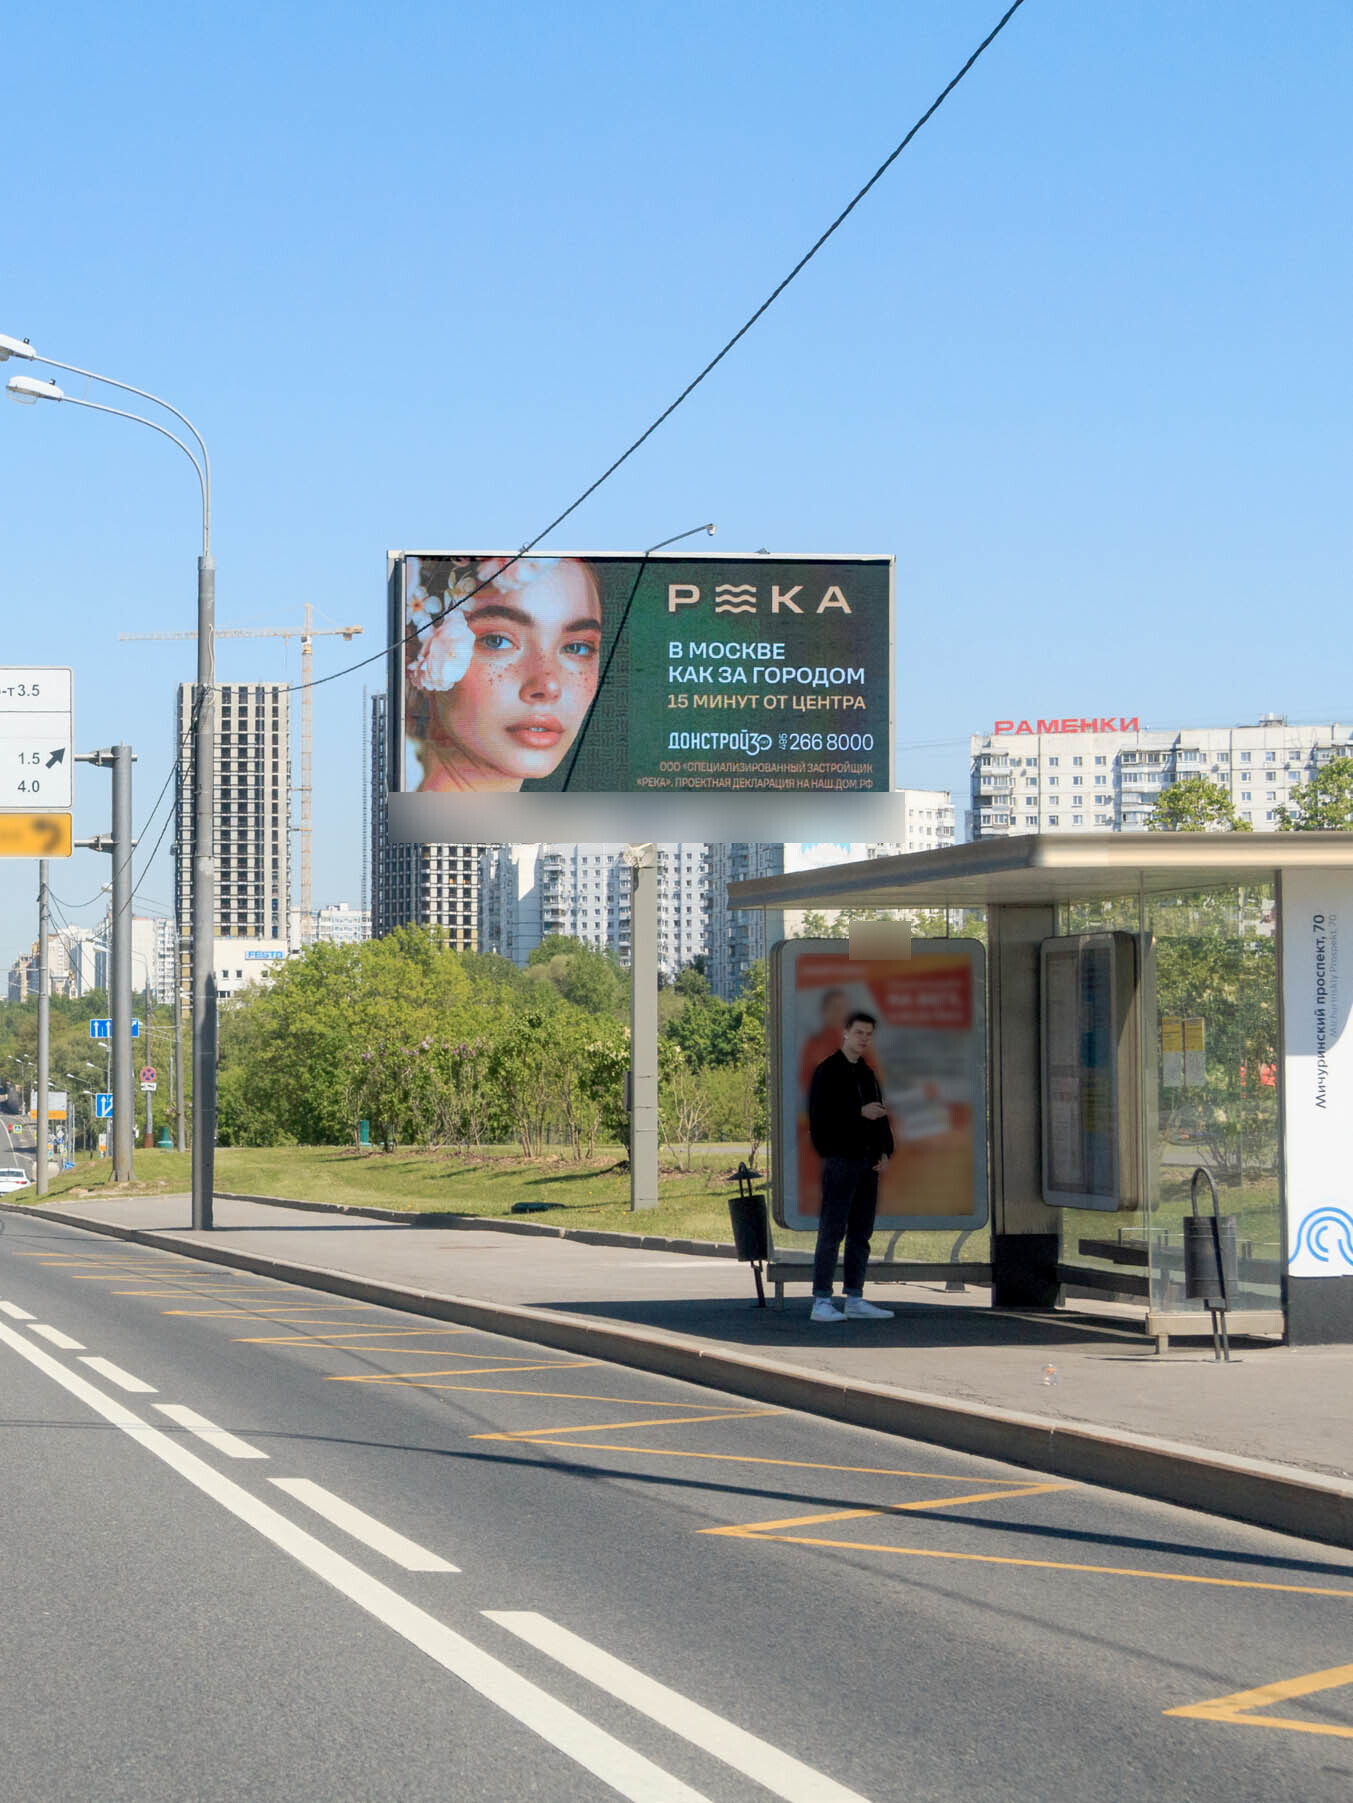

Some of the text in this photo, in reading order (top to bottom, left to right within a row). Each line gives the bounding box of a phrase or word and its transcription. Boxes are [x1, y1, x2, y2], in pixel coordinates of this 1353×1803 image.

[668, 642, 785, 660] В МОСКВЕ
[668, 666, 865, 688] КАК ЗА ГОРОДОМ
[17, 684, 40, 697] 3.5
[668, 694, 867, 712] 15 МИНУТ ОТ ЦЕНТРА
[994, 717, 1139, 735] РАМЕНКИ
[790, 733, 822, 751] 266
[826, 733, 874, 751] 8000
[18, 753, 40, 765] 1.5
[659, 761, 680, 772] ООО
[17, 780, 40, 793] 4.0
[1313, 914, 1328, 1109] Мичуринский проспект, 70
